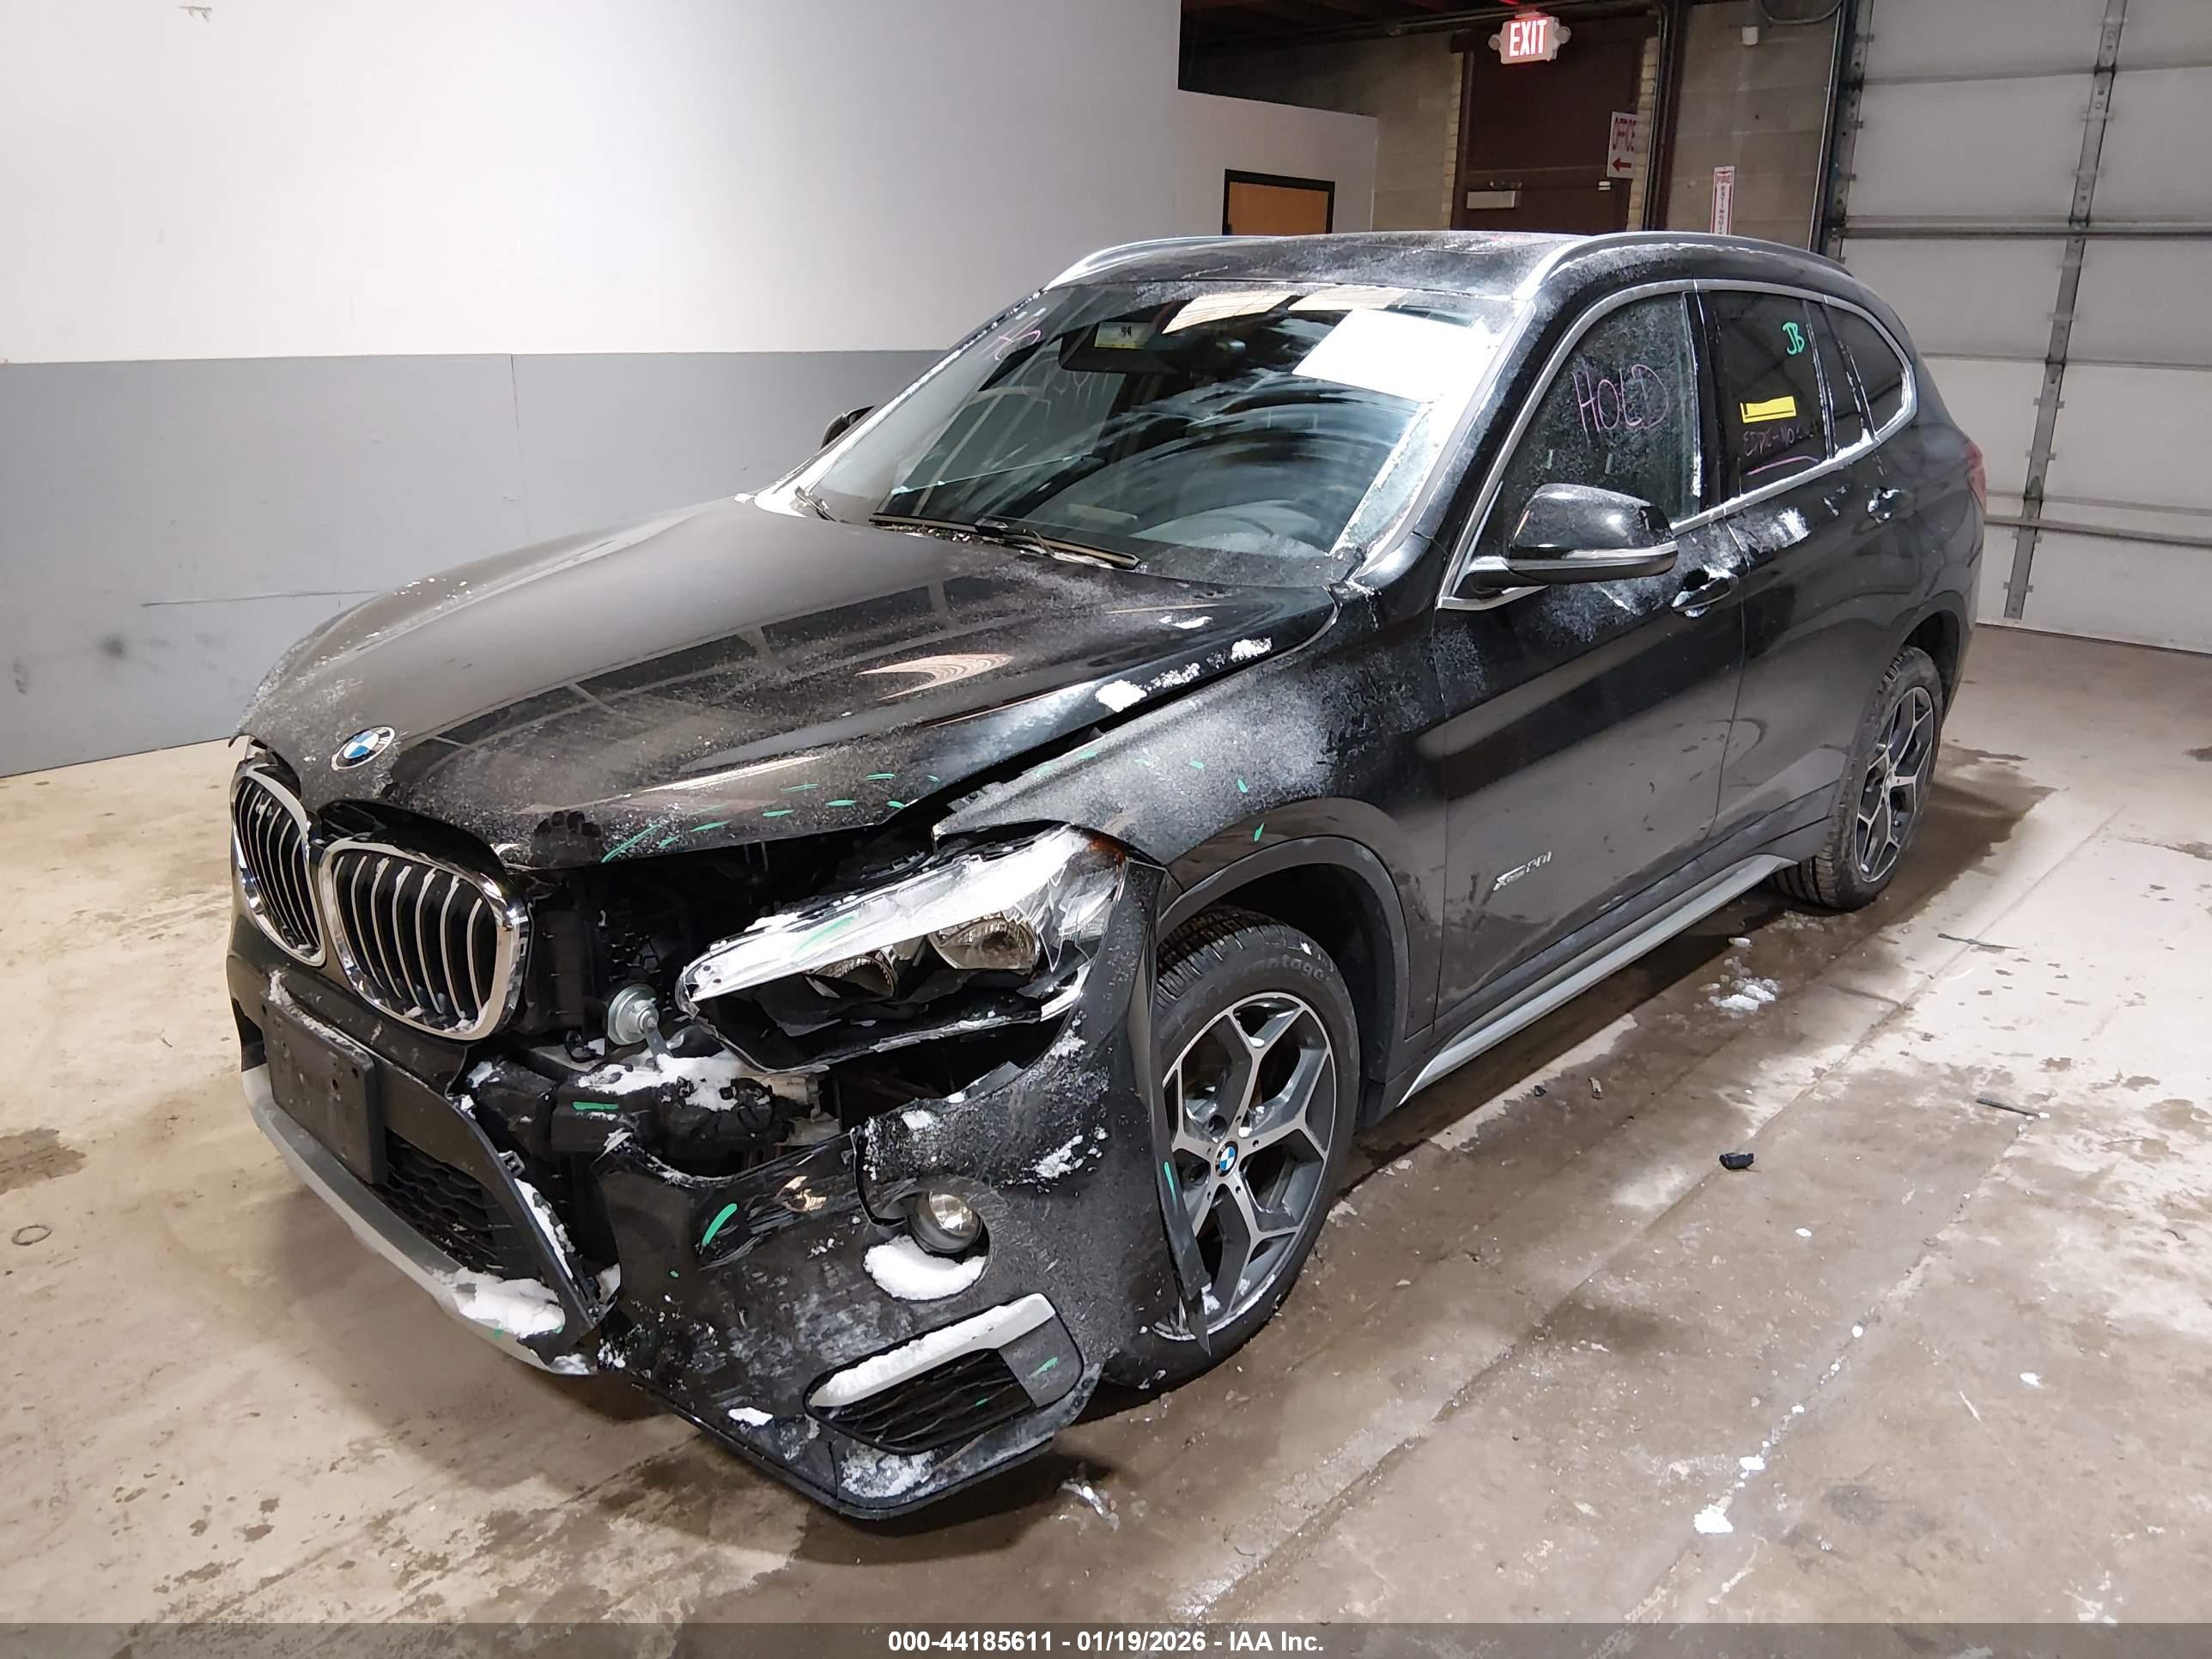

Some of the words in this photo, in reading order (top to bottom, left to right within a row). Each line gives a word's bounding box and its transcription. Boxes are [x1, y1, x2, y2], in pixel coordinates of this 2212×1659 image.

[1509, 19, 1547, 57] EXIT
[1612, 116, 1637, 152] OFFICE
[1717, 174, 1732, 184] FIRE
[1571, 363, 1670, 443] HOLD
